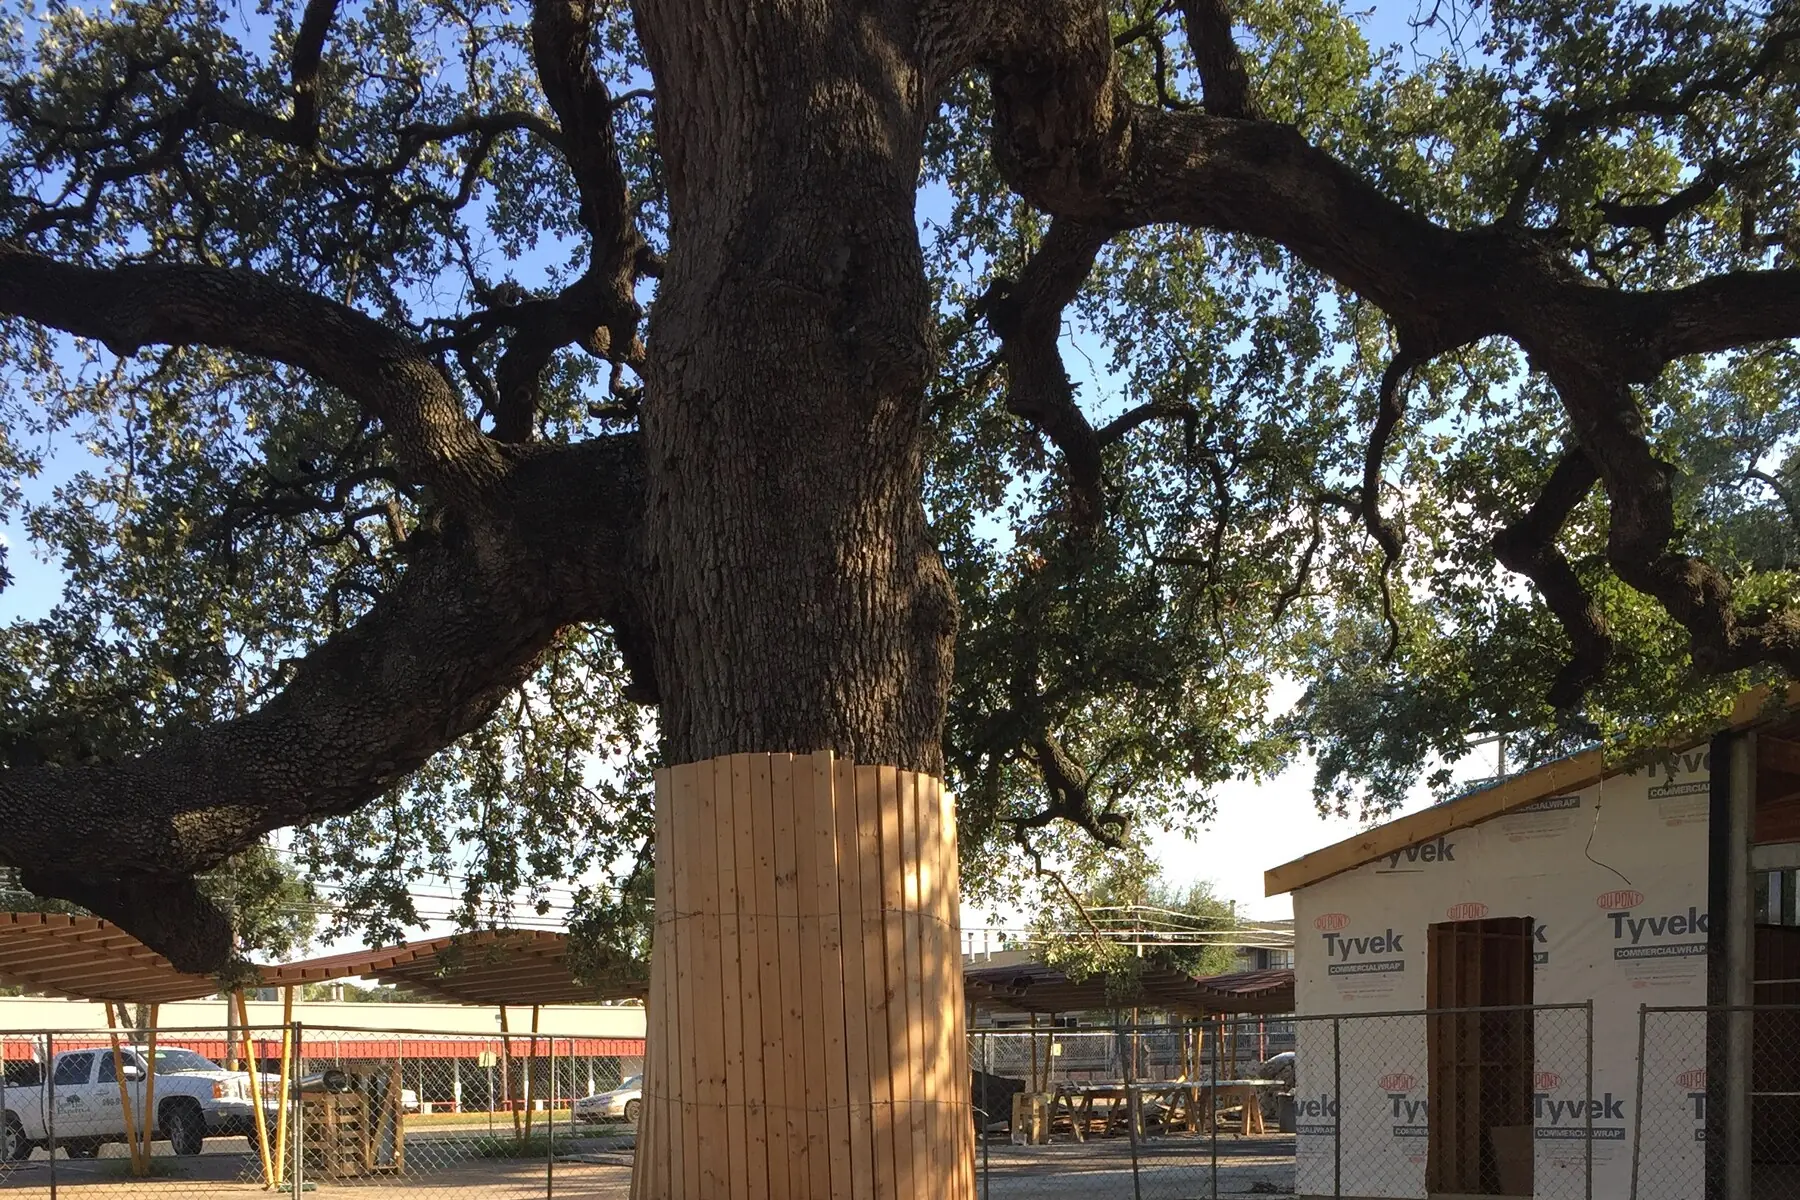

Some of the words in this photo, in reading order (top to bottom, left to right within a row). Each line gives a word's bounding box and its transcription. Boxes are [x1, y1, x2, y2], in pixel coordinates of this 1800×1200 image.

[1376, 837, 1456, 869] yvek
[1607, 906, 1708, 945] Tyvek
[1322, 928, 1405, 961] Tyvek
[1615, 944, 1706, 958] COMMERCIALWRAP
[1329, 962, 1401, 974] COMMERCIALWRAP
[1534, 1092, 1625, 1125] Tyvek
